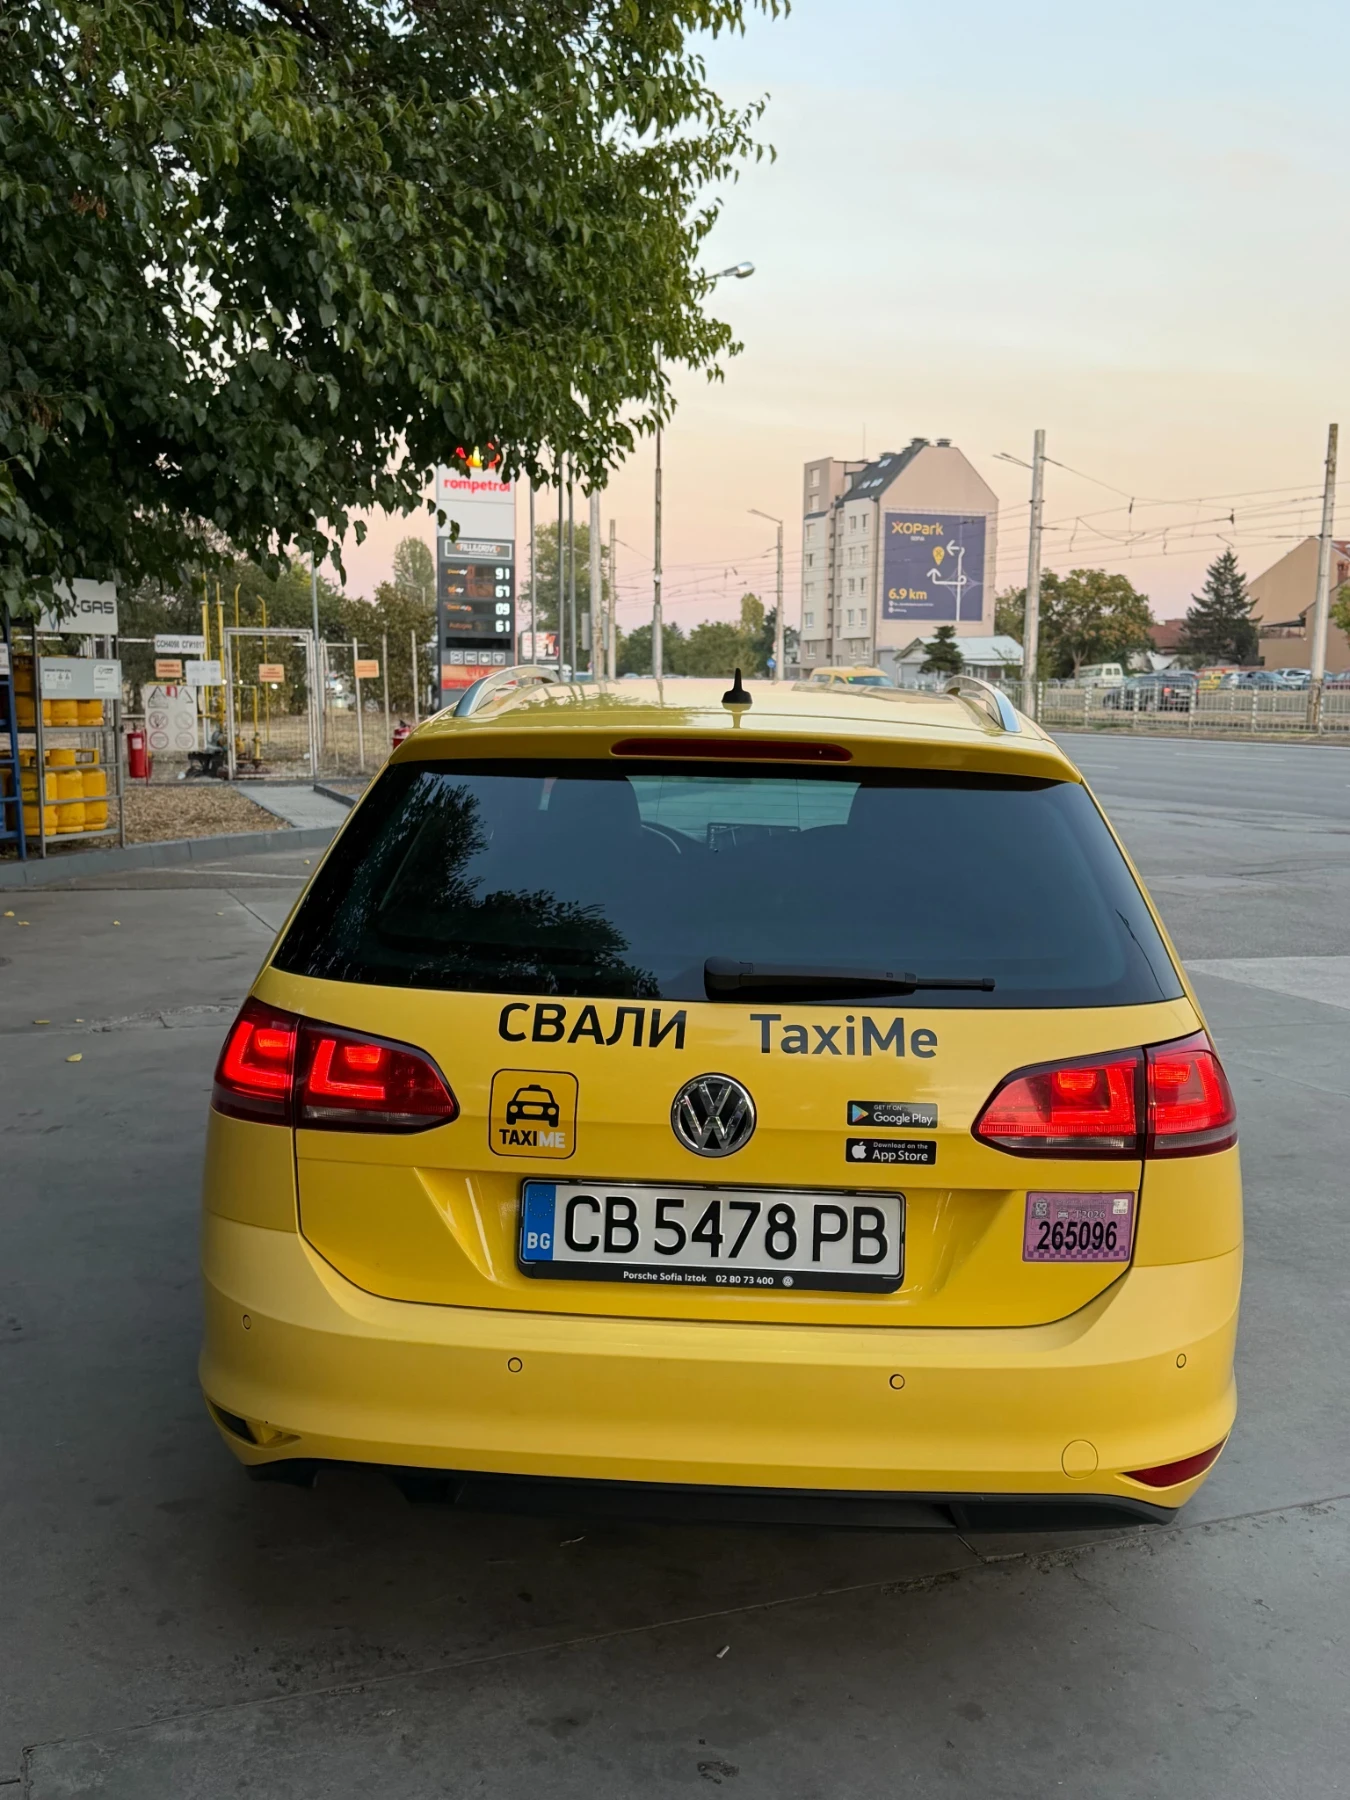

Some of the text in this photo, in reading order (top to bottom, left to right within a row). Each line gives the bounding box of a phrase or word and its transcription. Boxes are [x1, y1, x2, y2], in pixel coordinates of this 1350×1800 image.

[443, 479, 511, 494] rompetrol
[495, 567, 510, 580] 91
[495, 585, 510, 598] 67
[888, 588, 927, 600] 6.9 km
[495, 602, 510, 616] 09
[495, 620, 510, 633] 61
[498, 1002, 687, 1050] СВАЛИ
[749, 1012, 938, 1059] TaxiMe
[873, 1111, 933, 1126] Google Play
[873, 1141, 906, 1149] Download
[872, 1149, 928, 1162] App Store
[654, 1198, 797, 1261] 5478
[1036, 1220, 1118, 1251] 265096
[526, 1232, 551, 1250] BG
[623, 1270, 774, 1286] Porsche Sofia Iztok 02 80 73 400
